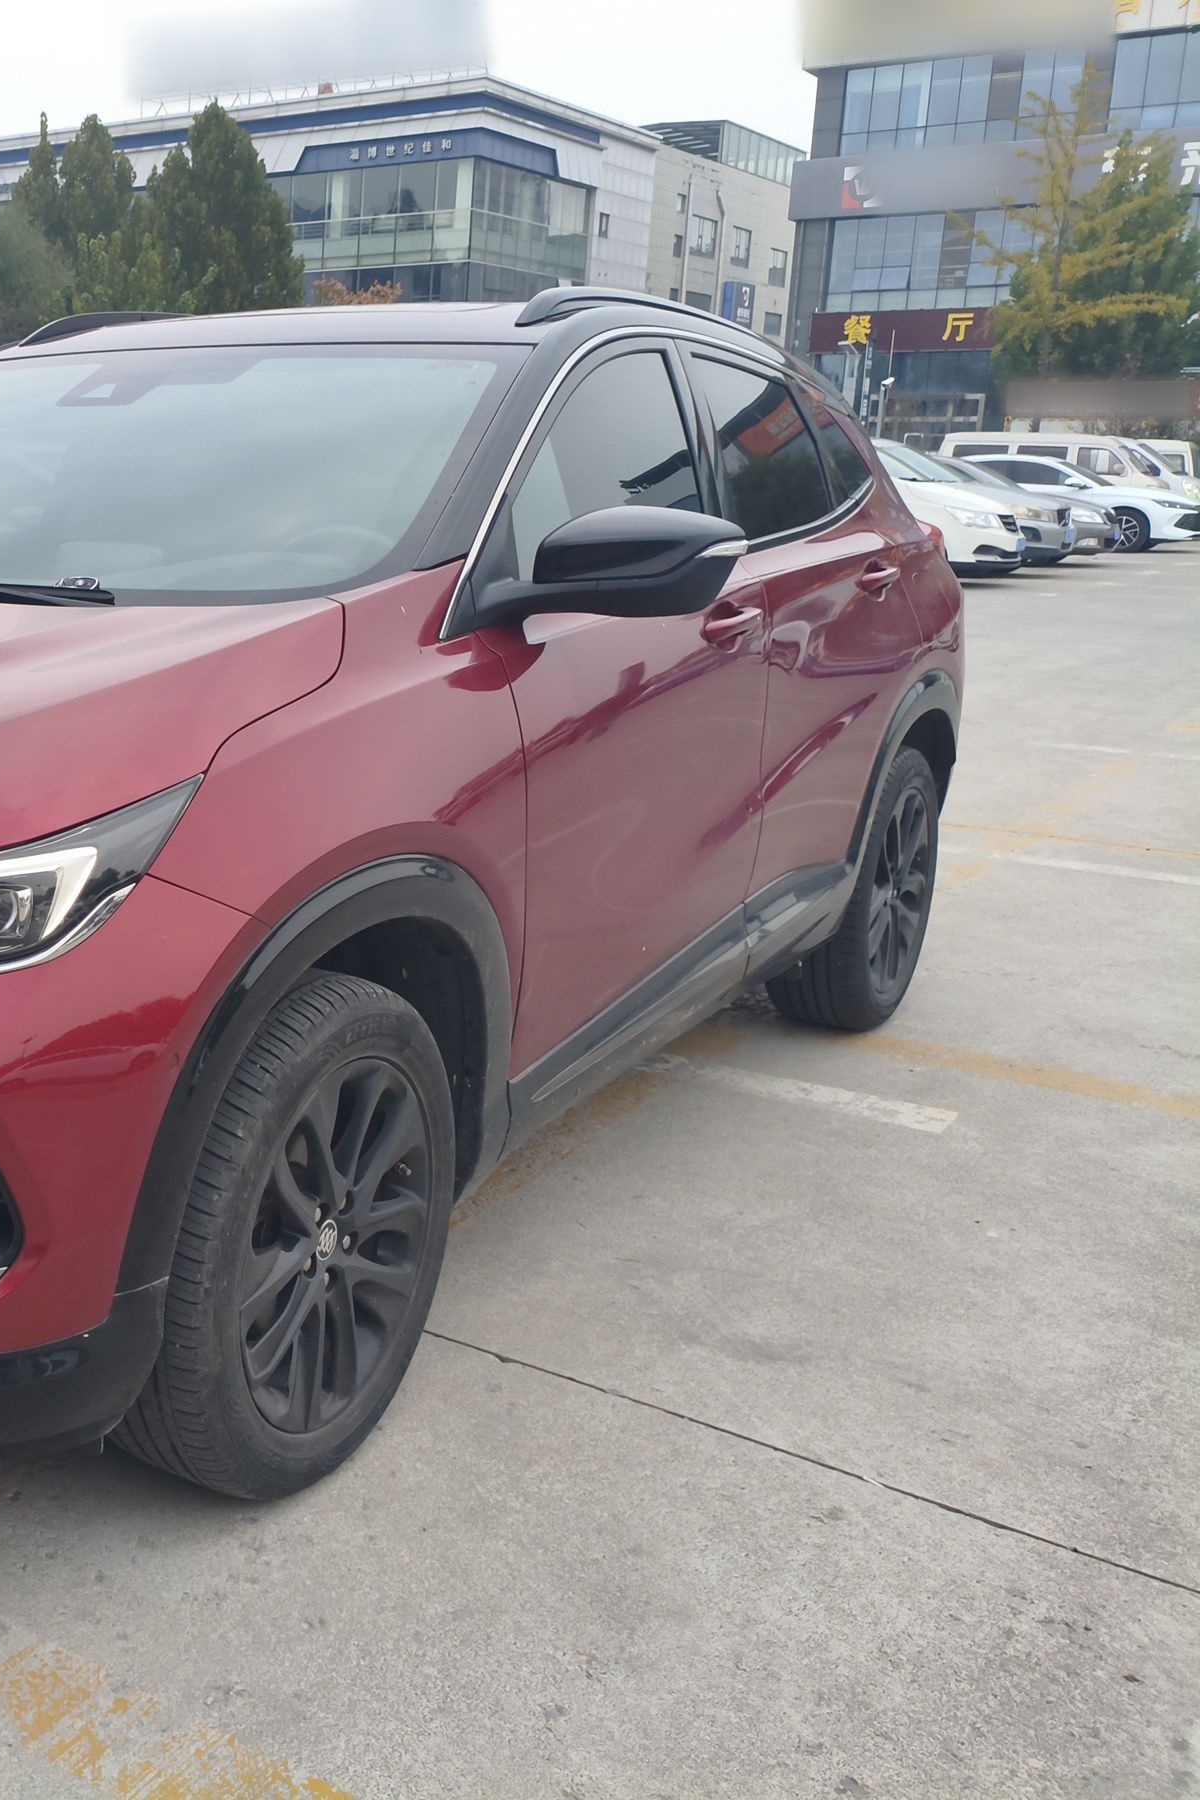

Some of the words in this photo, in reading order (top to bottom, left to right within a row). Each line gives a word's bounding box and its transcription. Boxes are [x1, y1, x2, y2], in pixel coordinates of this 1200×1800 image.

[349, 138, 452, 161] 淄博世纪佳和
[844, 314, 974, 345] 餐厅
